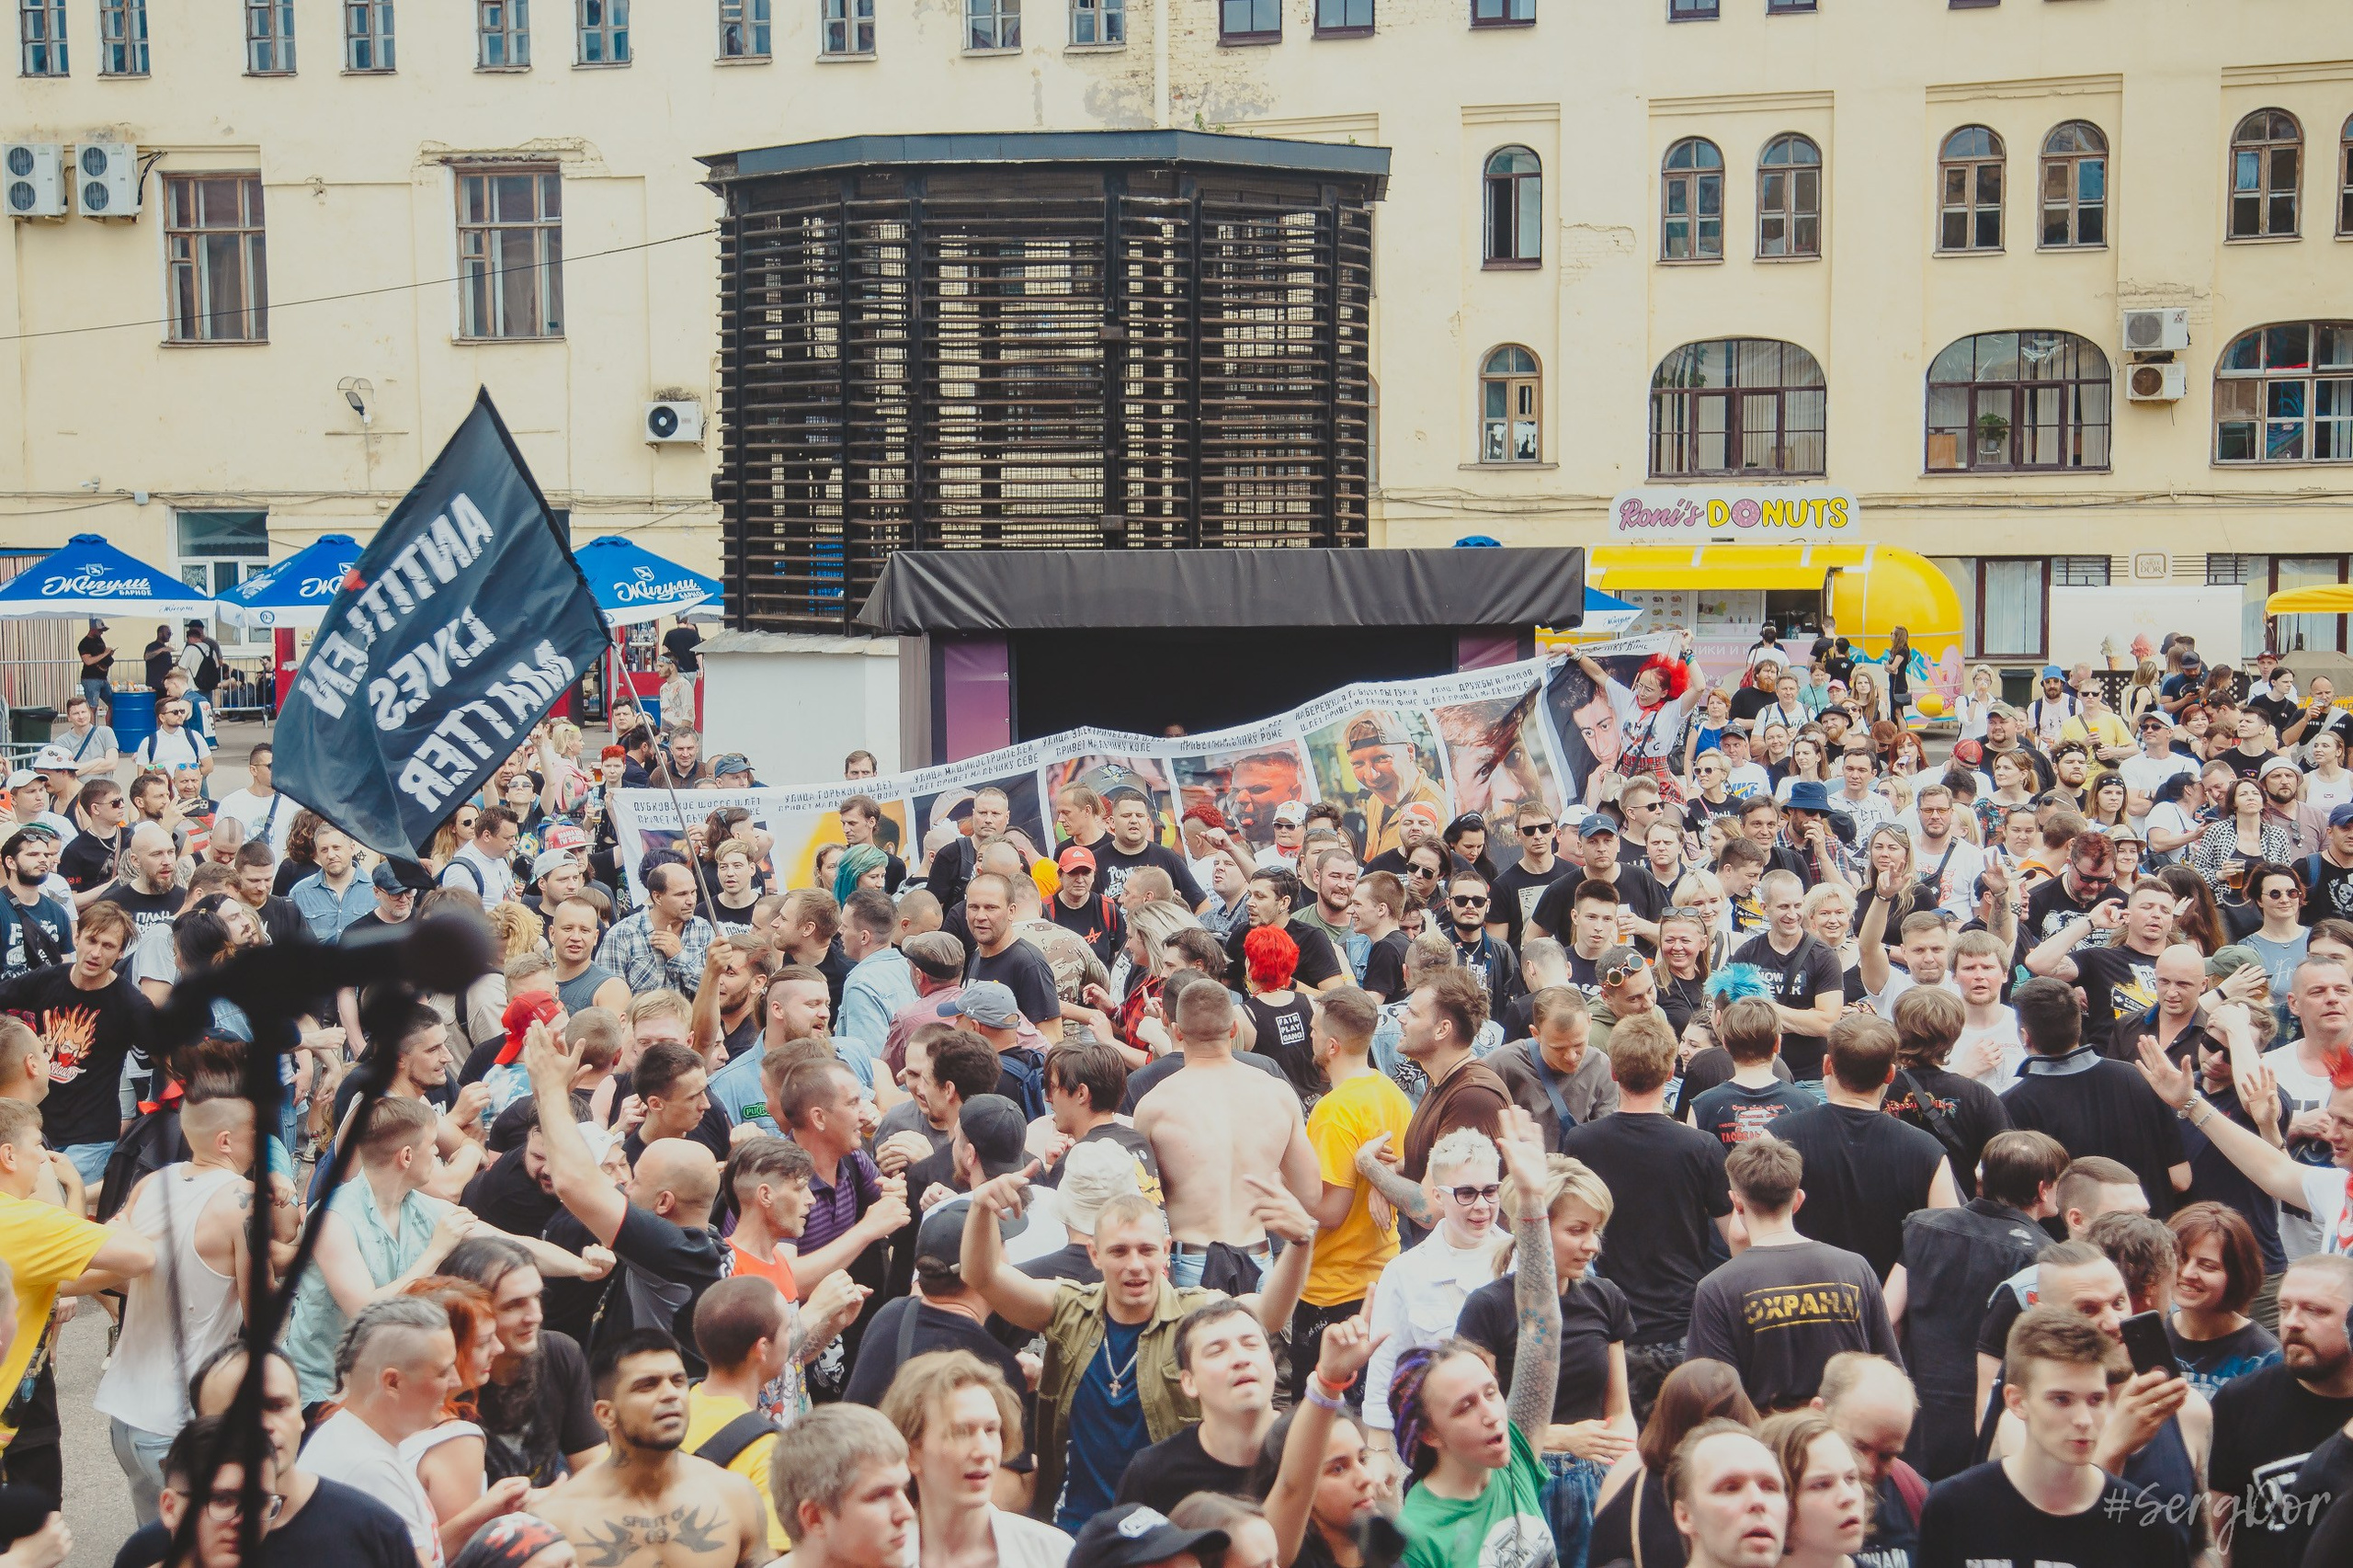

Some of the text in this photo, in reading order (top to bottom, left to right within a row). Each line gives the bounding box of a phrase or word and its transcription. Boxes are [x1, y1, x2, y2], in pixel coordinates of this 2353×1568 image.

[1620, 496, 1849, 530] Roni's DONUTS
[41, 575, 152, 597] Жигули
[613, 578, 702, 602] Жигули
[678, 590, 706, 601] БАРНОЕ
[1458, 676, 1495, 692] ДРУЖБЫ
[1295, 694, 1347, 721] НАБЕРЕЖНАЯ
[1041, 735, 1070, 747] УЛИЦА
[1260, 728, 1283, 743] РОМЕ
[1055, 738, 1152, 757] ПРИВЕТ МАЛЬЧИКУ КОЛЕ
[913, 770, 943, 784] УЛИЦА
[937, 774, 968, 788] ПРИВЕТ
[970, 759, 1015, 778] МАЛЬЧИКУ
[1017, 753, 1040, 767] СЕВЕ
[784, 793, 815, 803] УЛИЦА
[817, 786, 865, 801] ГОРЬКОГО
[1278, 1015, 1300, 1026] FAIR
[1280, 1023, 1302, 1034] PLAY
[1282, 1031, 1303, 1041] GANG
